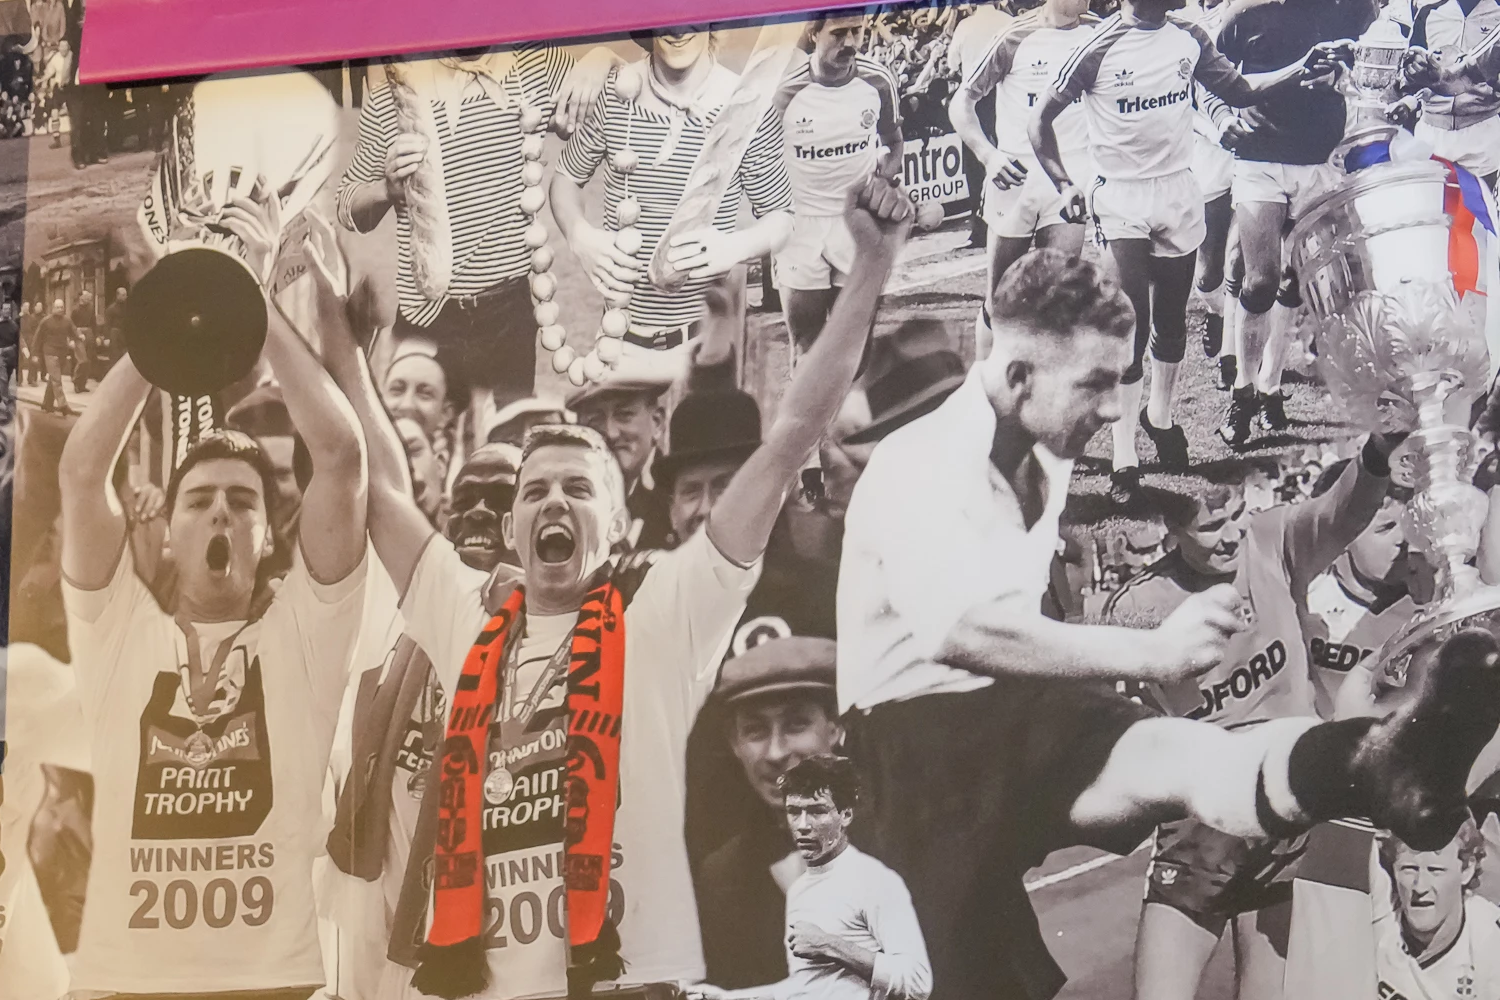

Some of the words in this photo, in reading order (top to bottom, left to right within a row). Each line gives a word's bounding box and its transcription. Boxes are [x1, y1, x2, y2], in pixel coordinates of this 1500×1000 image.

[909, 180, 964, 203] GROUP
[161, 766, 237, 789] PAINT
[510, 766, 566, 801] AIN
[144, 789, 253, 815] TROPHY
[129, 842, 275, 873] WINNERS
[127, 875, 275, 929] 2009
